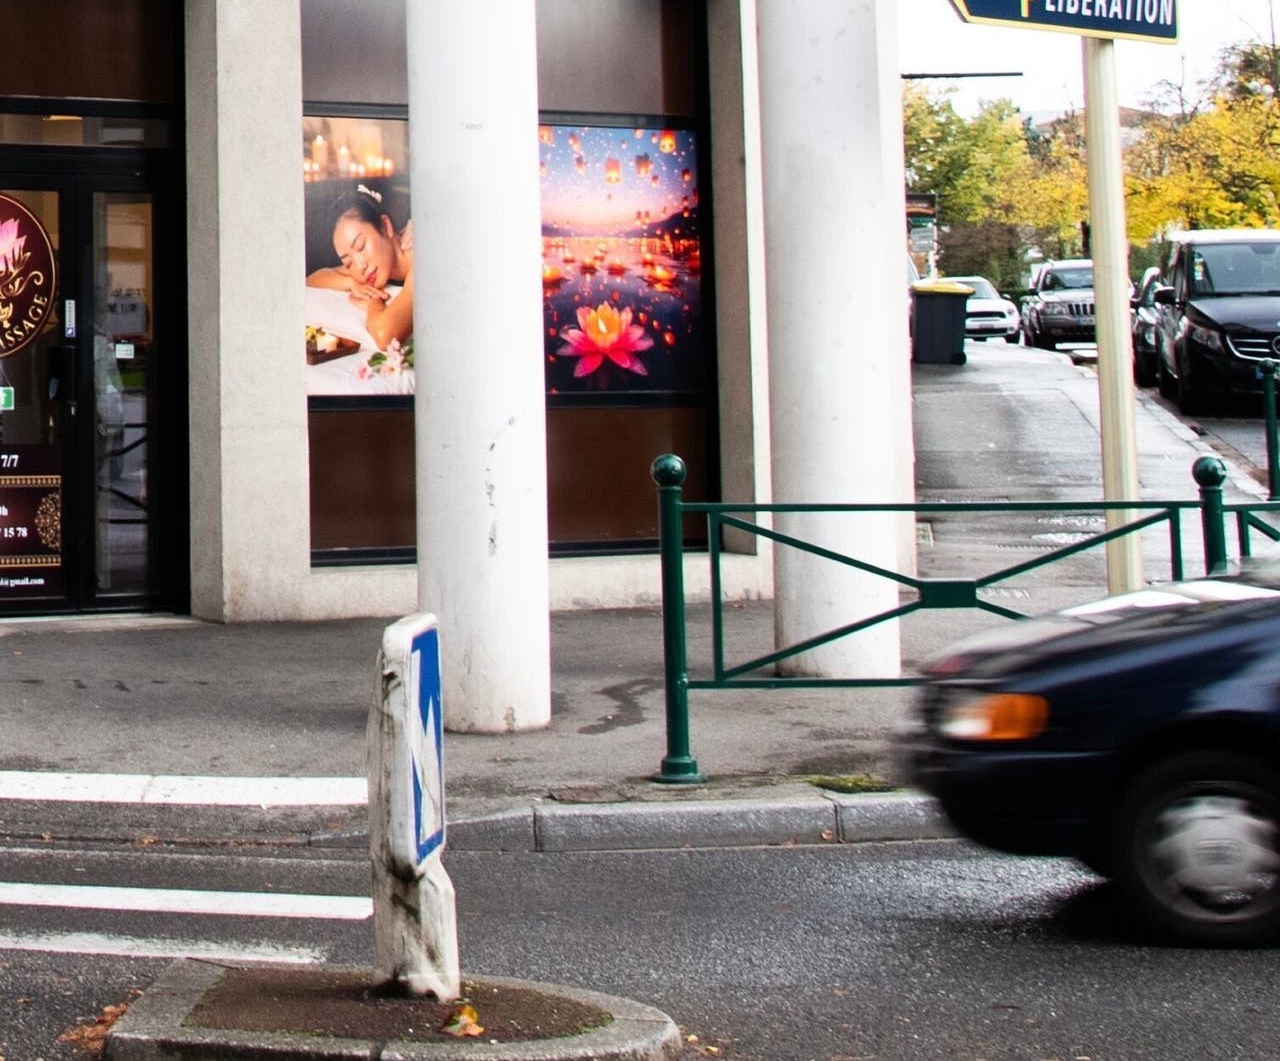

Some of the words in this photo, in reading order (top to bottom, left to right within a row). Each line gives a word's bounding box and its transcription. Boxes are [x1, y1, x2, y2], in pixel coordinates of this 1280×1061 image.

[0, 454, 20, 468] 7/7
[4, 527, 15, 538] 15
[17, 527, 28, 538] 78
